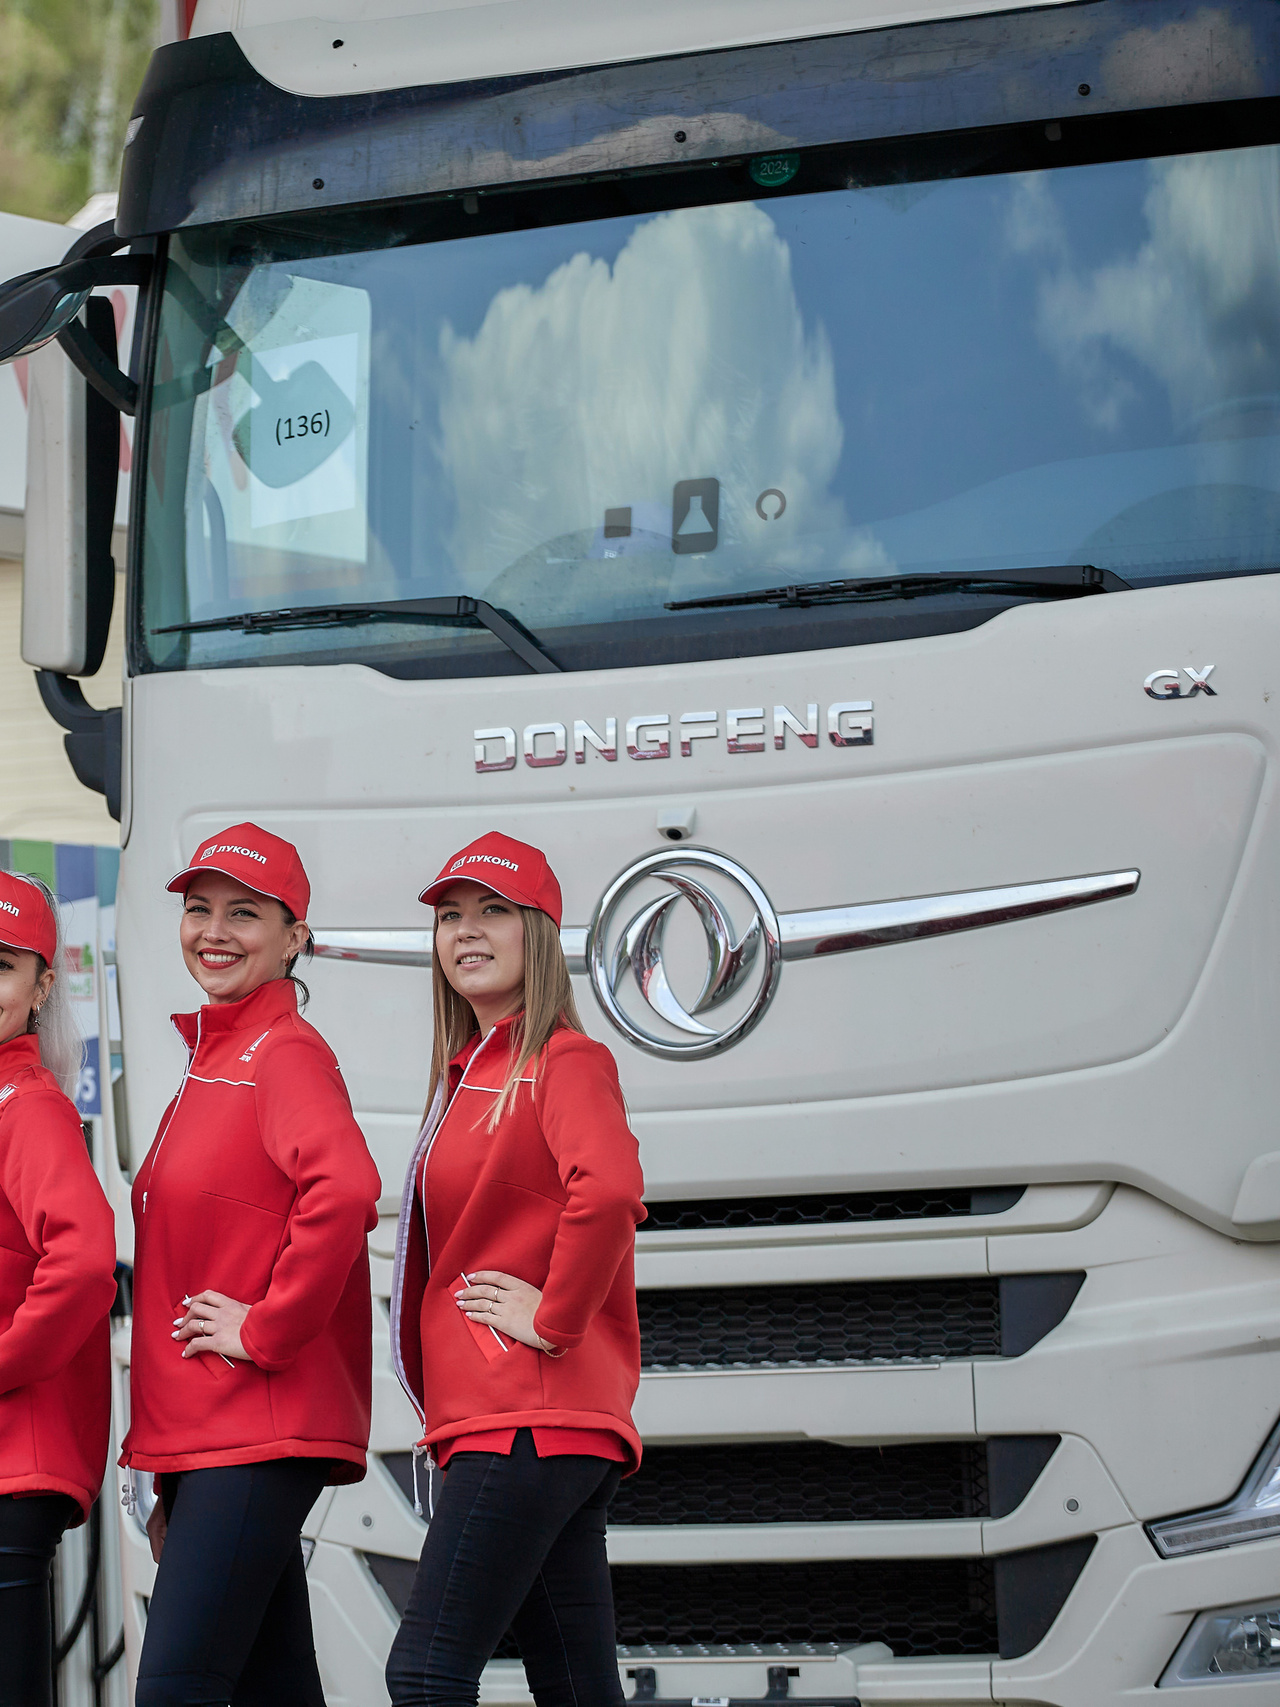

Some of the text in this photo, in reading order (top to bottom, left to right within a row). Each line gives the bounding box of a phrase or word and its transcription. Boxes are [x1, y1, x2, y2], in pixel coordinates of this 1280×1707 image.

[760, 160, 789, 176] 2024
[276, 409, 330, 446] (136)
[1143, 664, 1218, 700] GX
[473, 700, 873, 773] DONGFENG
[217, 845, 267, 864] ЛУКОЙЛ
[466, 855, 519, 872] ЛУКОЙЛ
